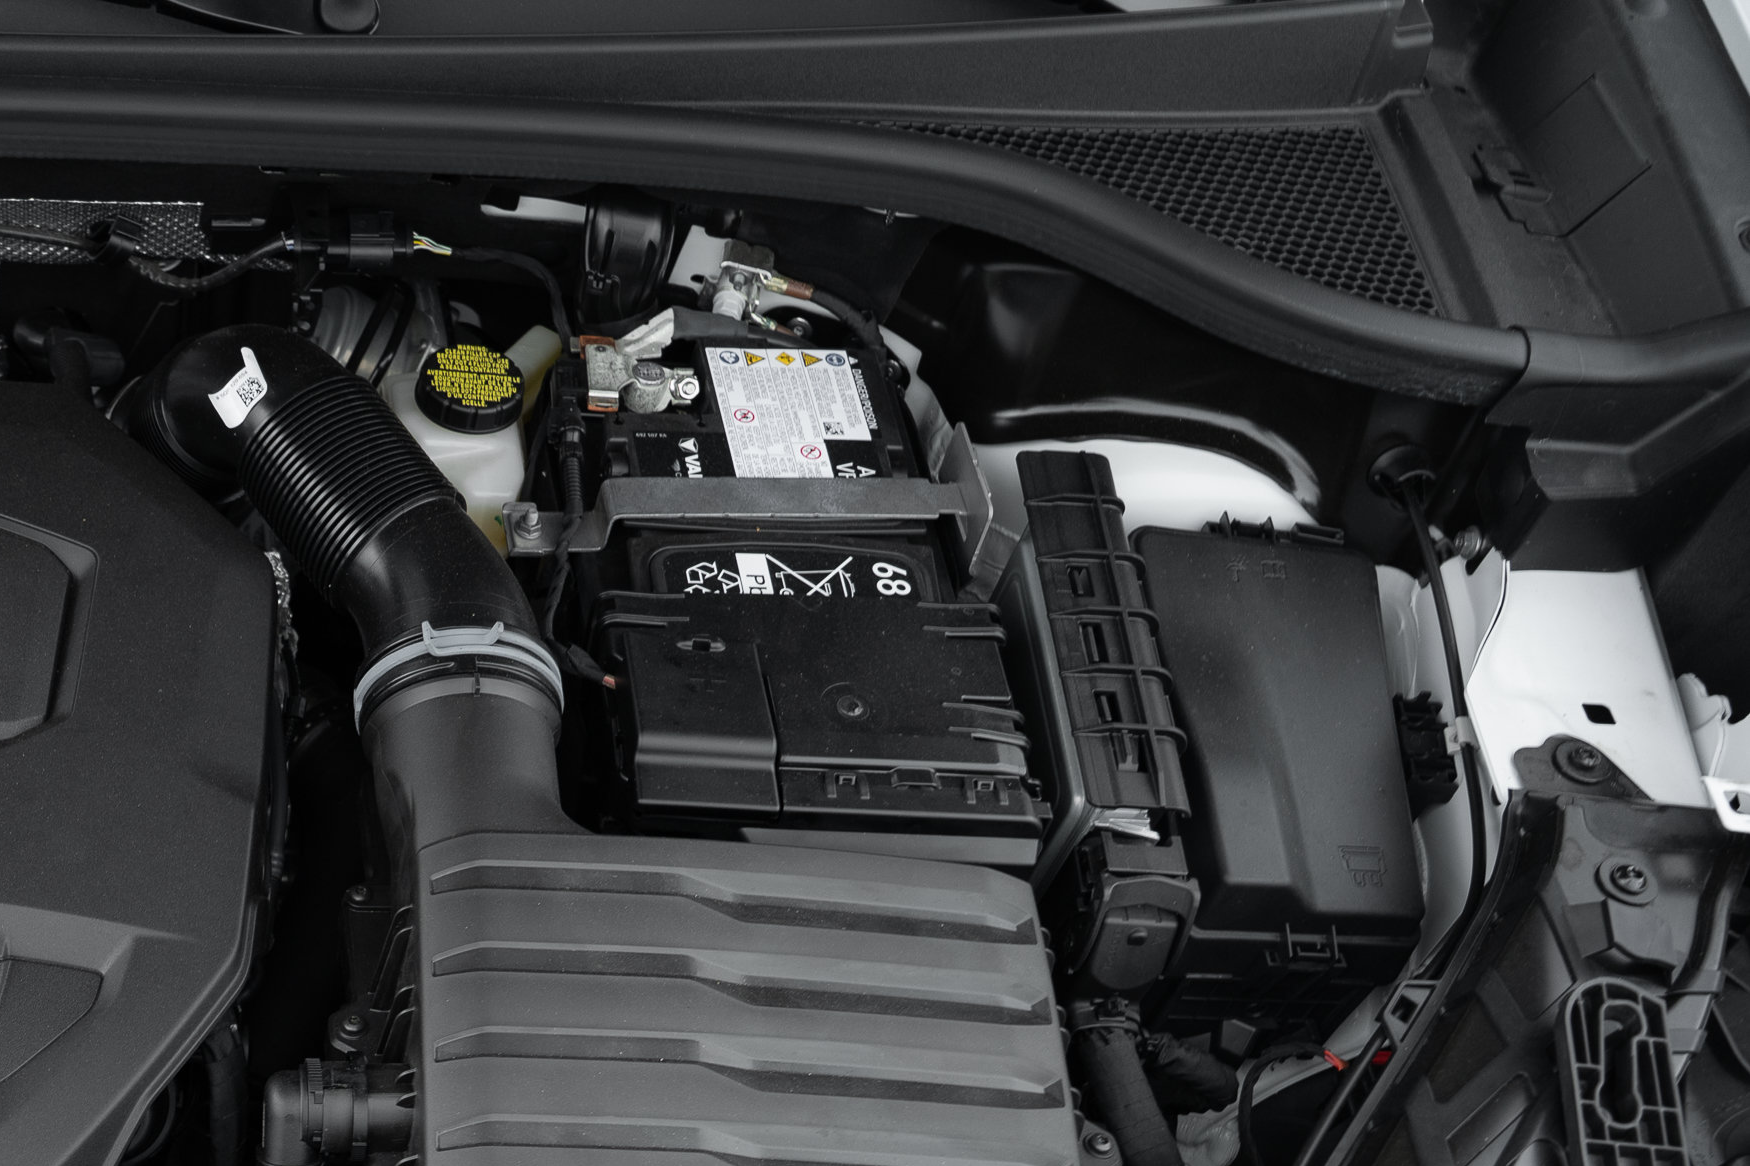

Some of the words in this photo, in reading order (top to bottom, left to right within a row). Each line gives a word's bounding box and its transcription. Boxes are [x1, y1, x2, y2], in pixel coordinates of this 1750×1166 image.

[437, 352, 461, 360] BEFORE
[445, 364, 469, 372] SEALED
[492, 362, 510, 370] FROM
[434, 376, 464, 385] BOUCHON
[465, 378, 486, 386] AVANT
